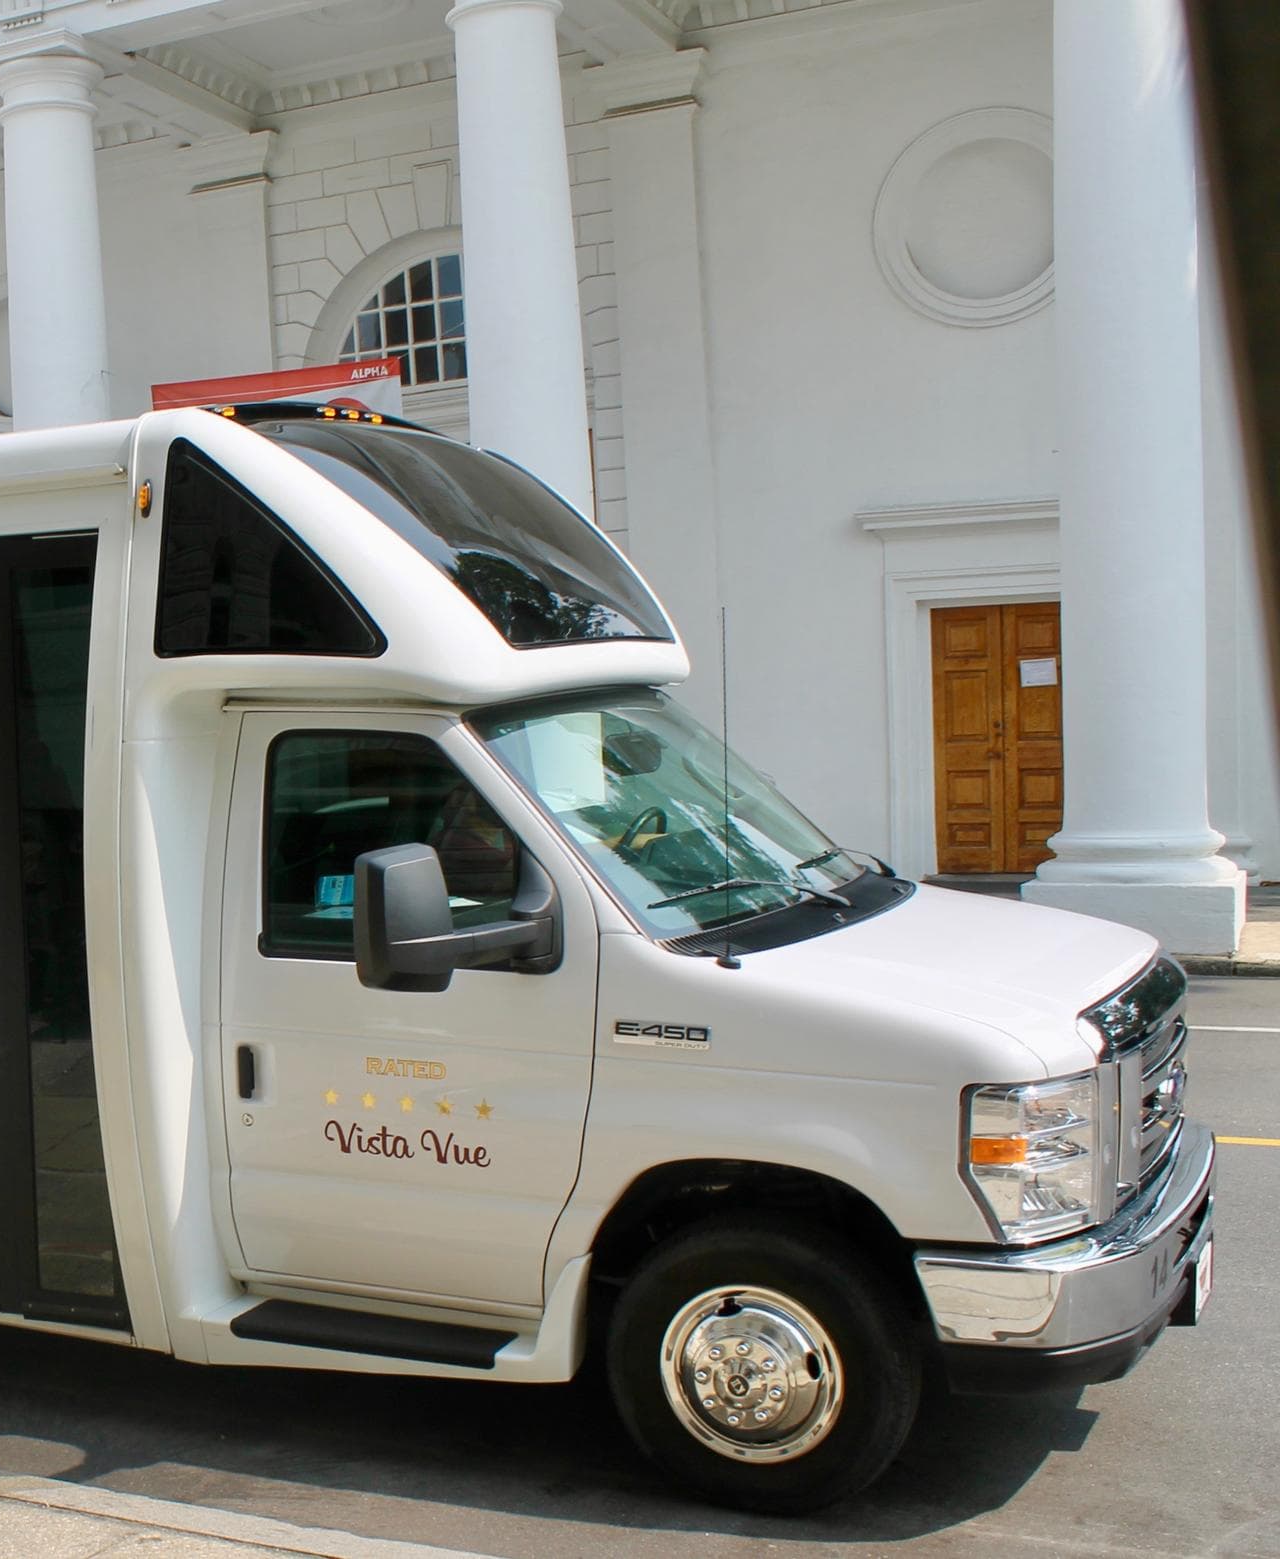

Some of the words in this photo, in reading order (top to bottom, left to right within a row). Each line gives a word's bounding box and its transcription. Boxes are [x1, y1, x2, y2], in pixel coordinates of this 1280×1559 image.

[351, 366, 388, 380] ALPHA
[615, 1021, 708, 1042] E-450
[365, 1056, 447, 1080] RATED
[324, 1120, 415, 1159] Vista
[420, 1129, 491, 1168] Vue
